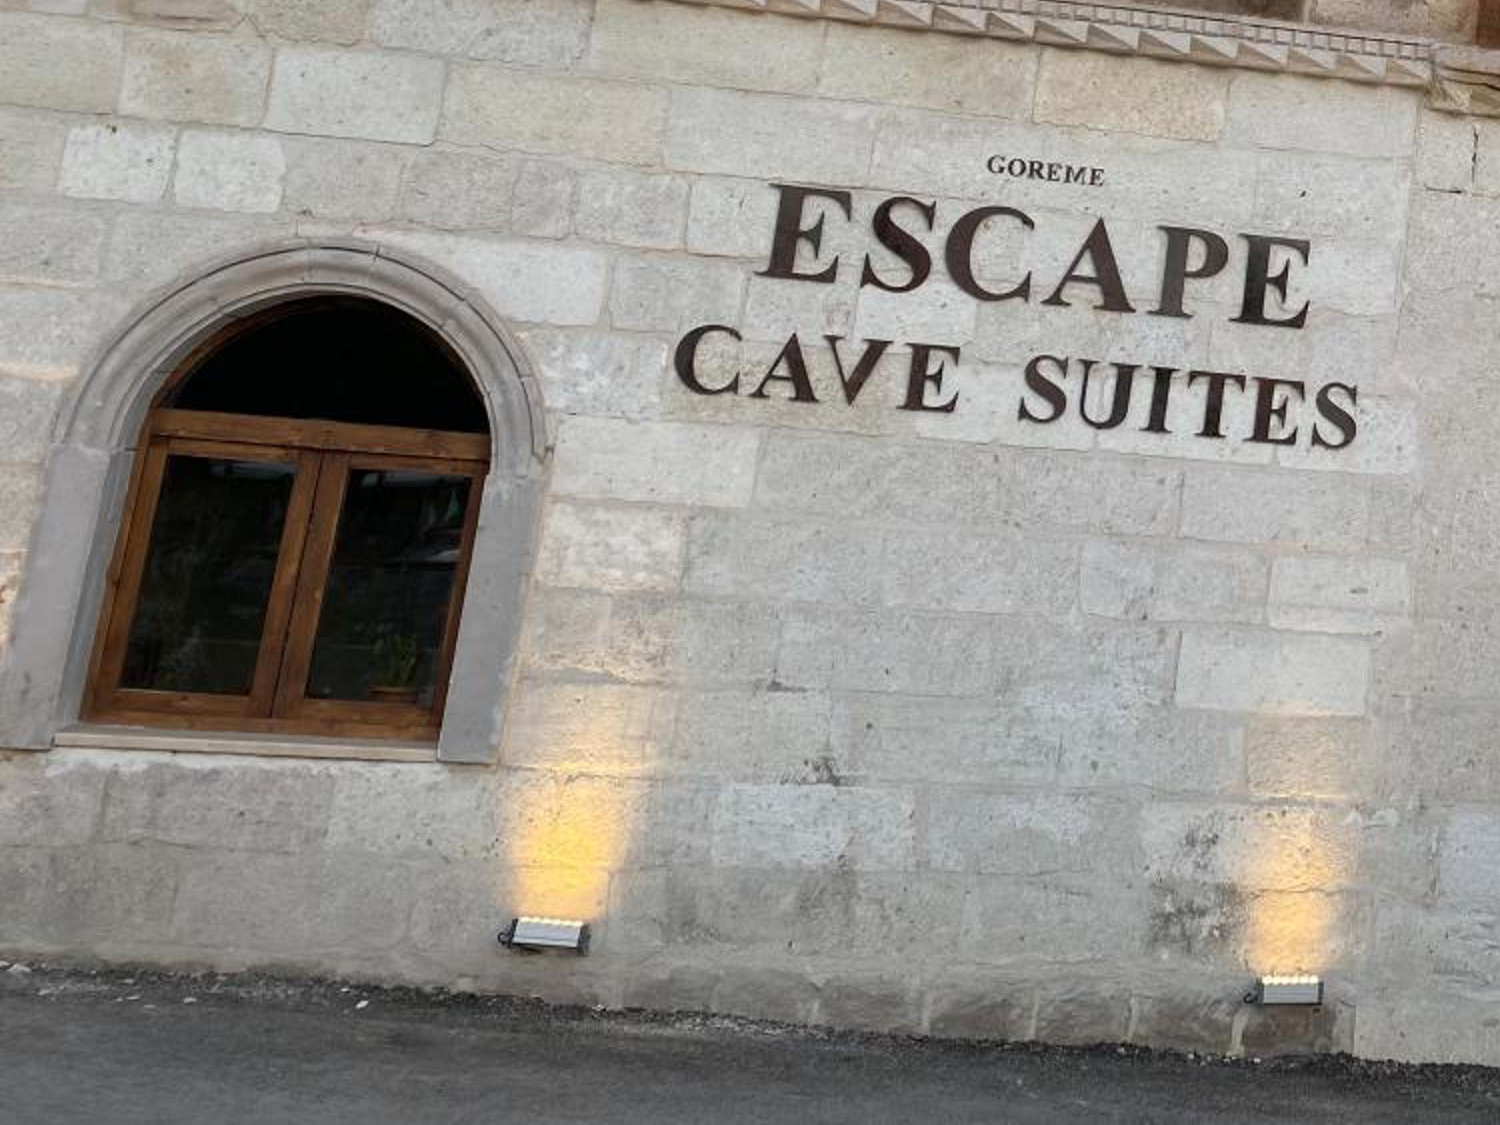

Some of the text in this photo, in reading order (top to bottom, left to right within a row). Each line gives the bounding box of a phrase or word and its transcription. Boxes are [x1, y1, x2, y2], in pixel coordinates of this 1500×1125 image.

[986, 154, 1106, 187] GOREME
[753, 182, 1313, 330] ESCAPE
[673, 324, 1360, 451] CAVE SUITES
